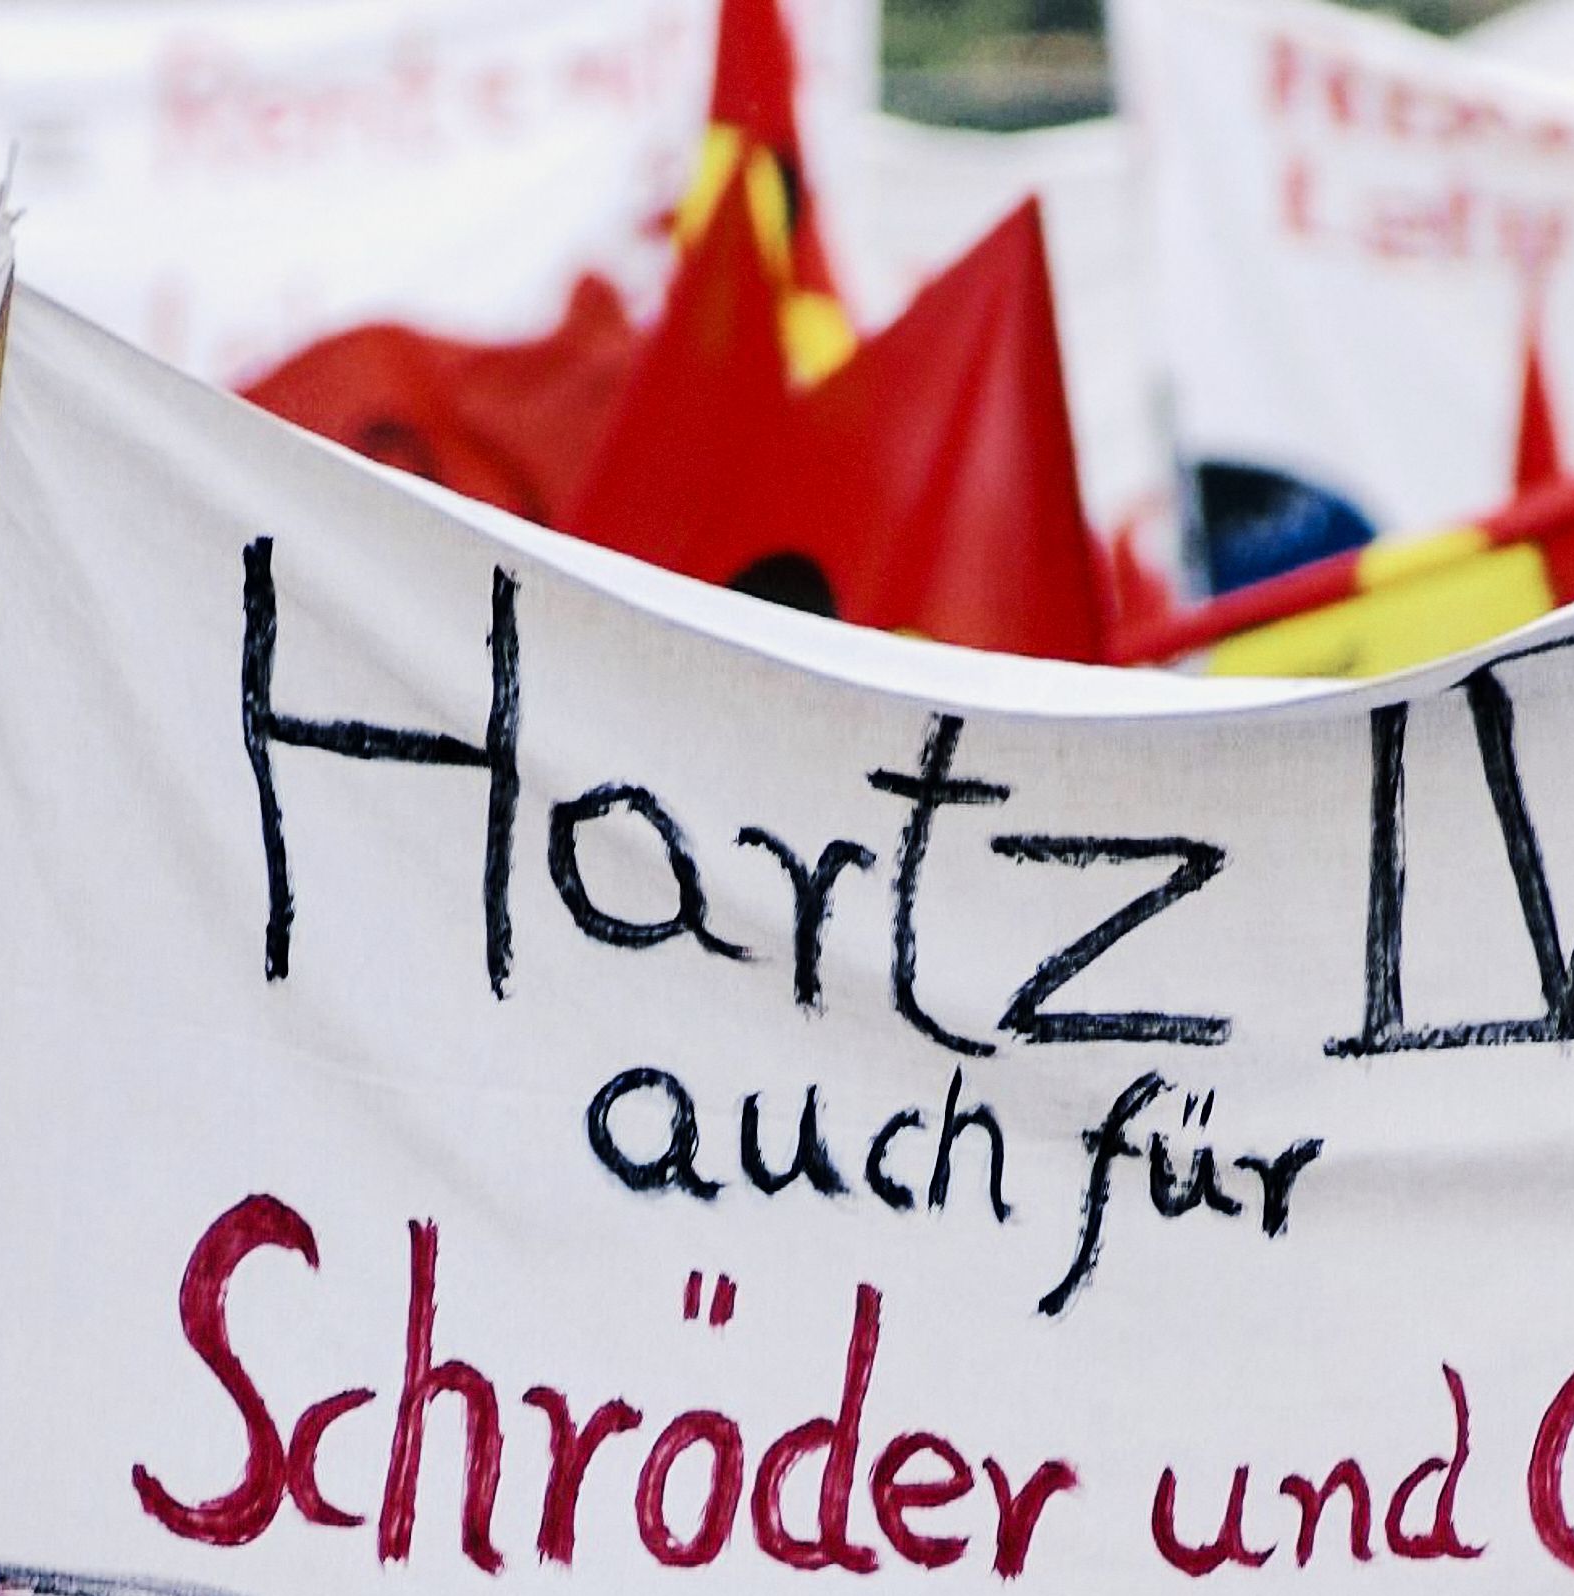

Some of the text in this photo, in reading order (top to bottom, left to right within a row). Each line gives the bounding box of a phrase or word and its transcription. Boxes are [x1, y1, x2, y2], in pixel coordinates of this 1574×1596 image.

[241, 535, 1231, 1058] Hartz
[131, 1190, 1081, 1582] Schröder
[1149, 1362, 1487, 1578] und
[585, 1064, 1325, 1318] auch für
